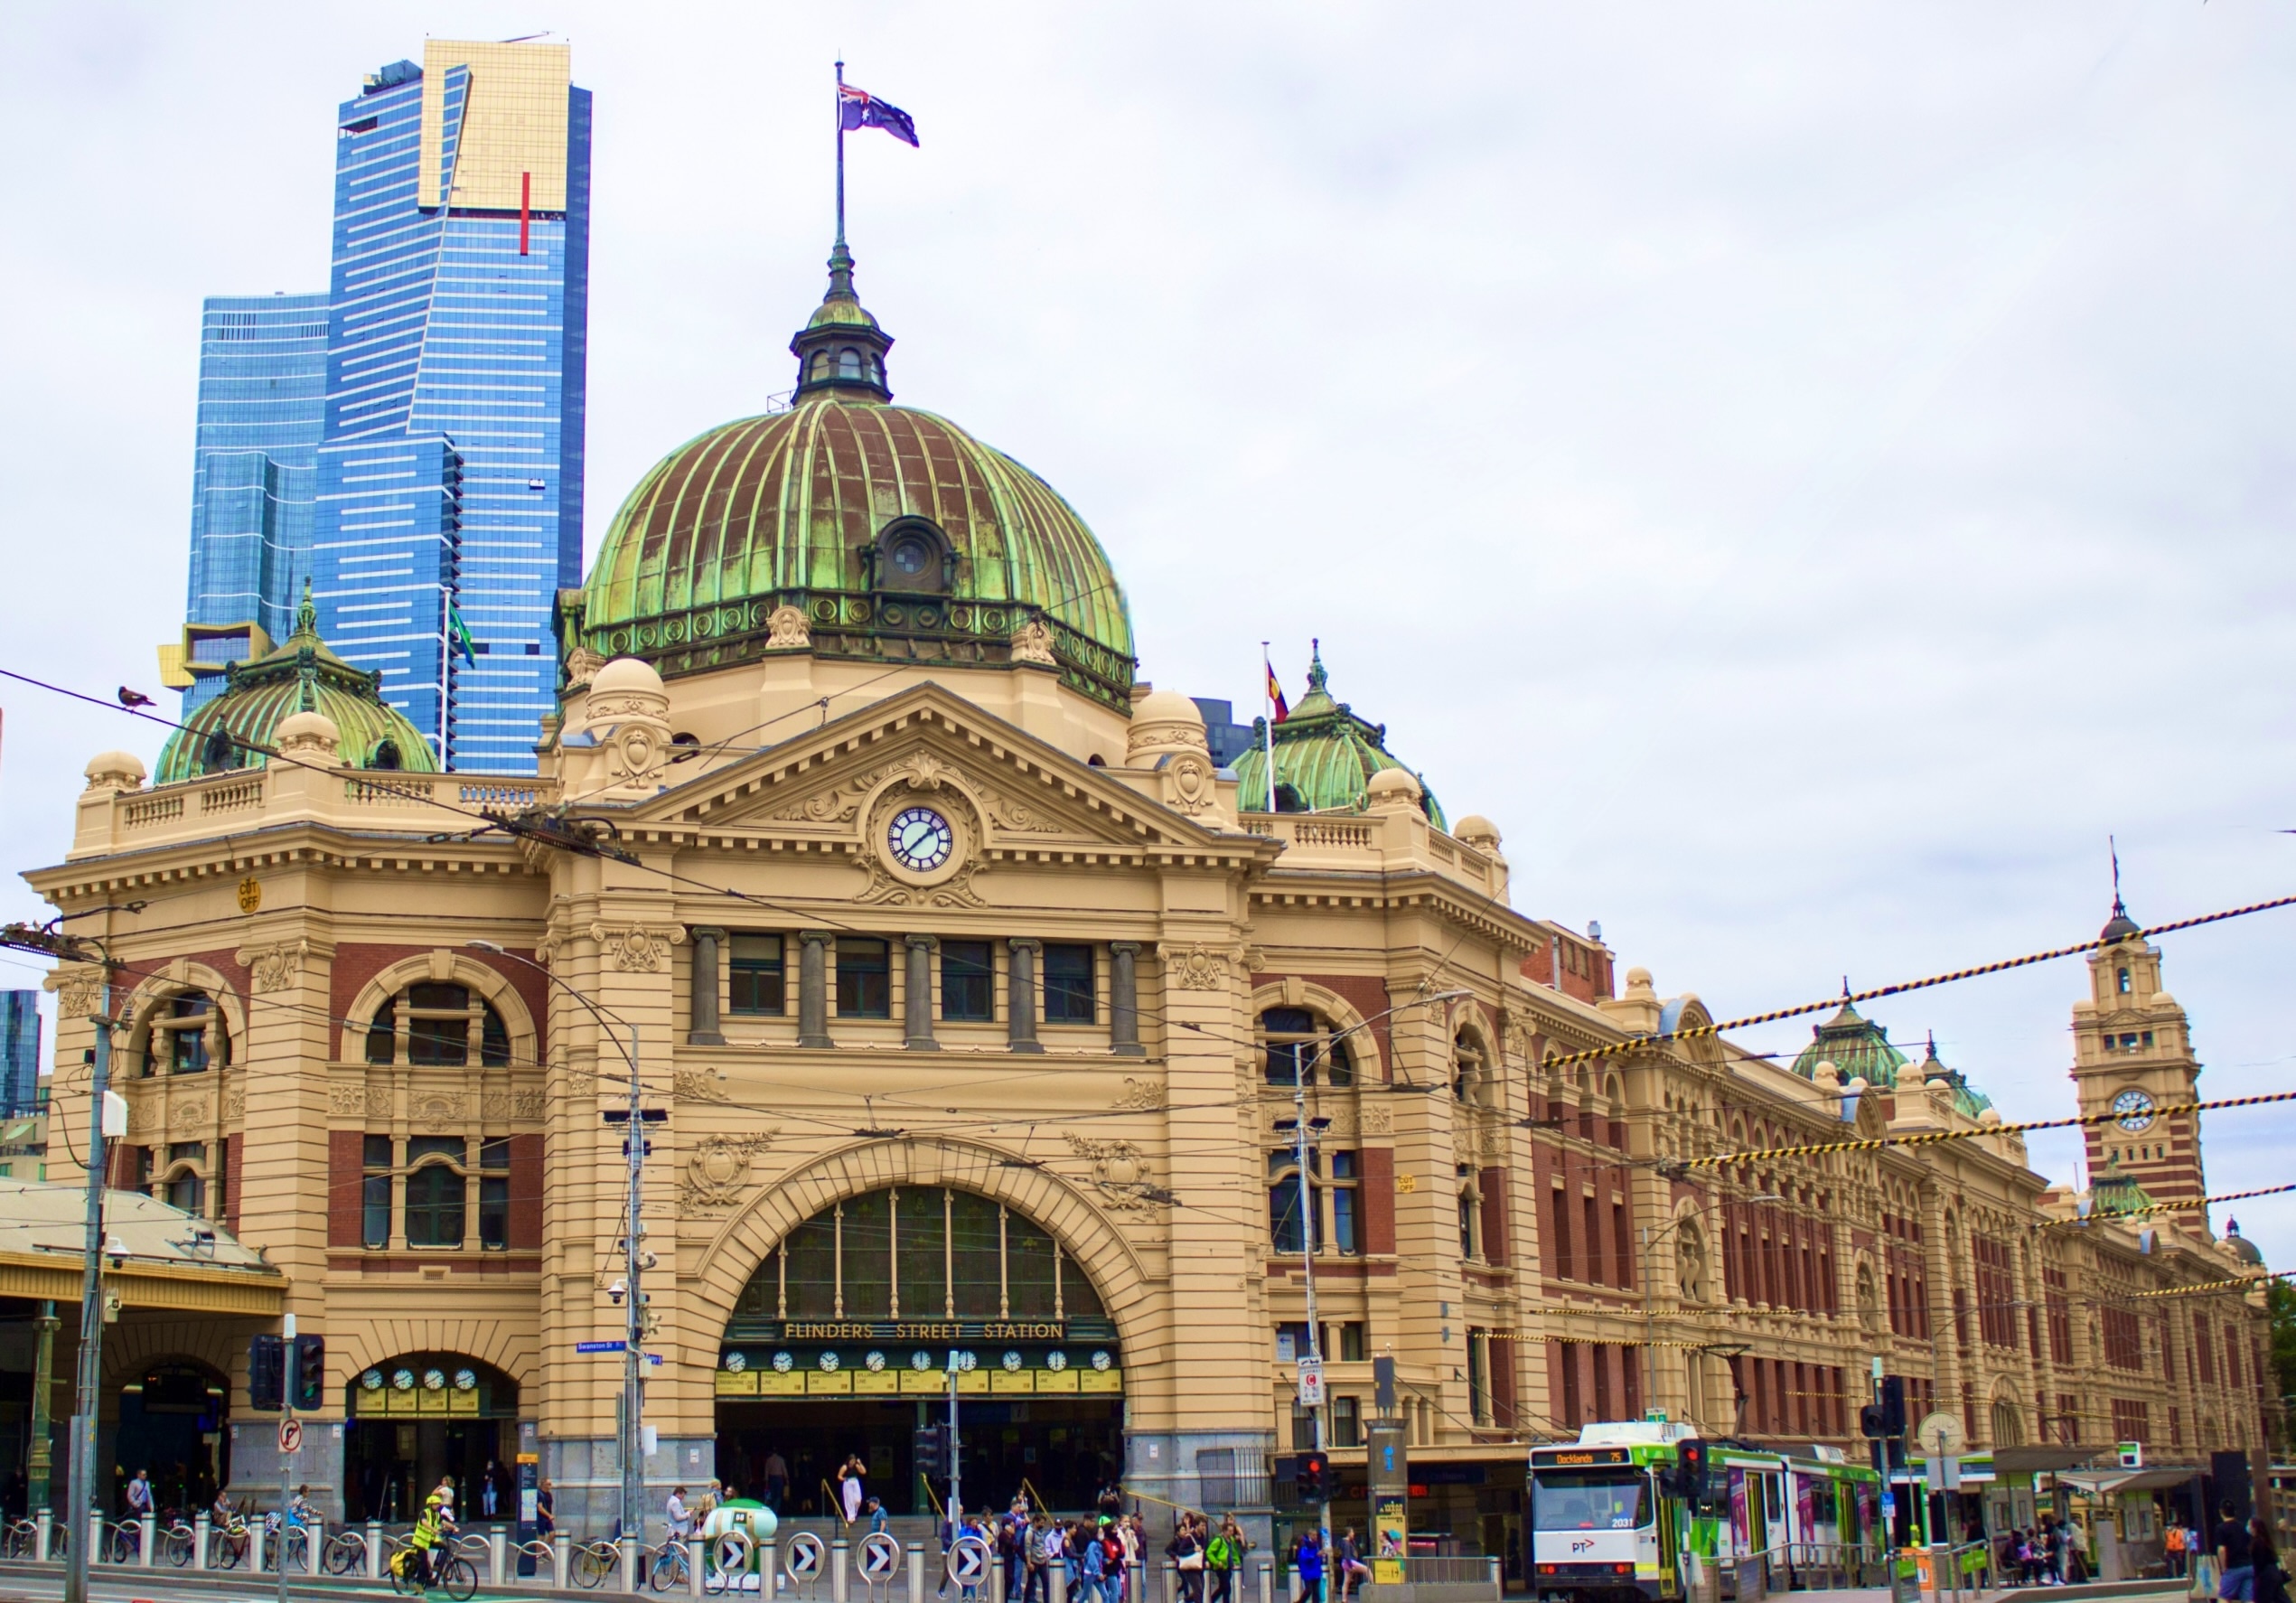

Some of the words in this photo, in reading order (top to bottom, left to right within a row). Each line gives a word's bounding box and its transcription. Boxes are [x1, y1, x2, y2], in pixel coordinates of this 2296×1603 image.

[239, 881, 257, 895] CUT
[240, 895, 258, 909] OFF
[785, 1323, 874, 1339] FLINDERS
[896, 1323, 963, 1339] STREET
[983, 1323, 1063, 1339] STATION
[577, 1343, 605, 1351] Swanston
[1556, 1453, 1594, 1465] Docklands
[1610, 1451, 1622, 1463] 75
[1611, 1518, 1634, 1528] 2031
